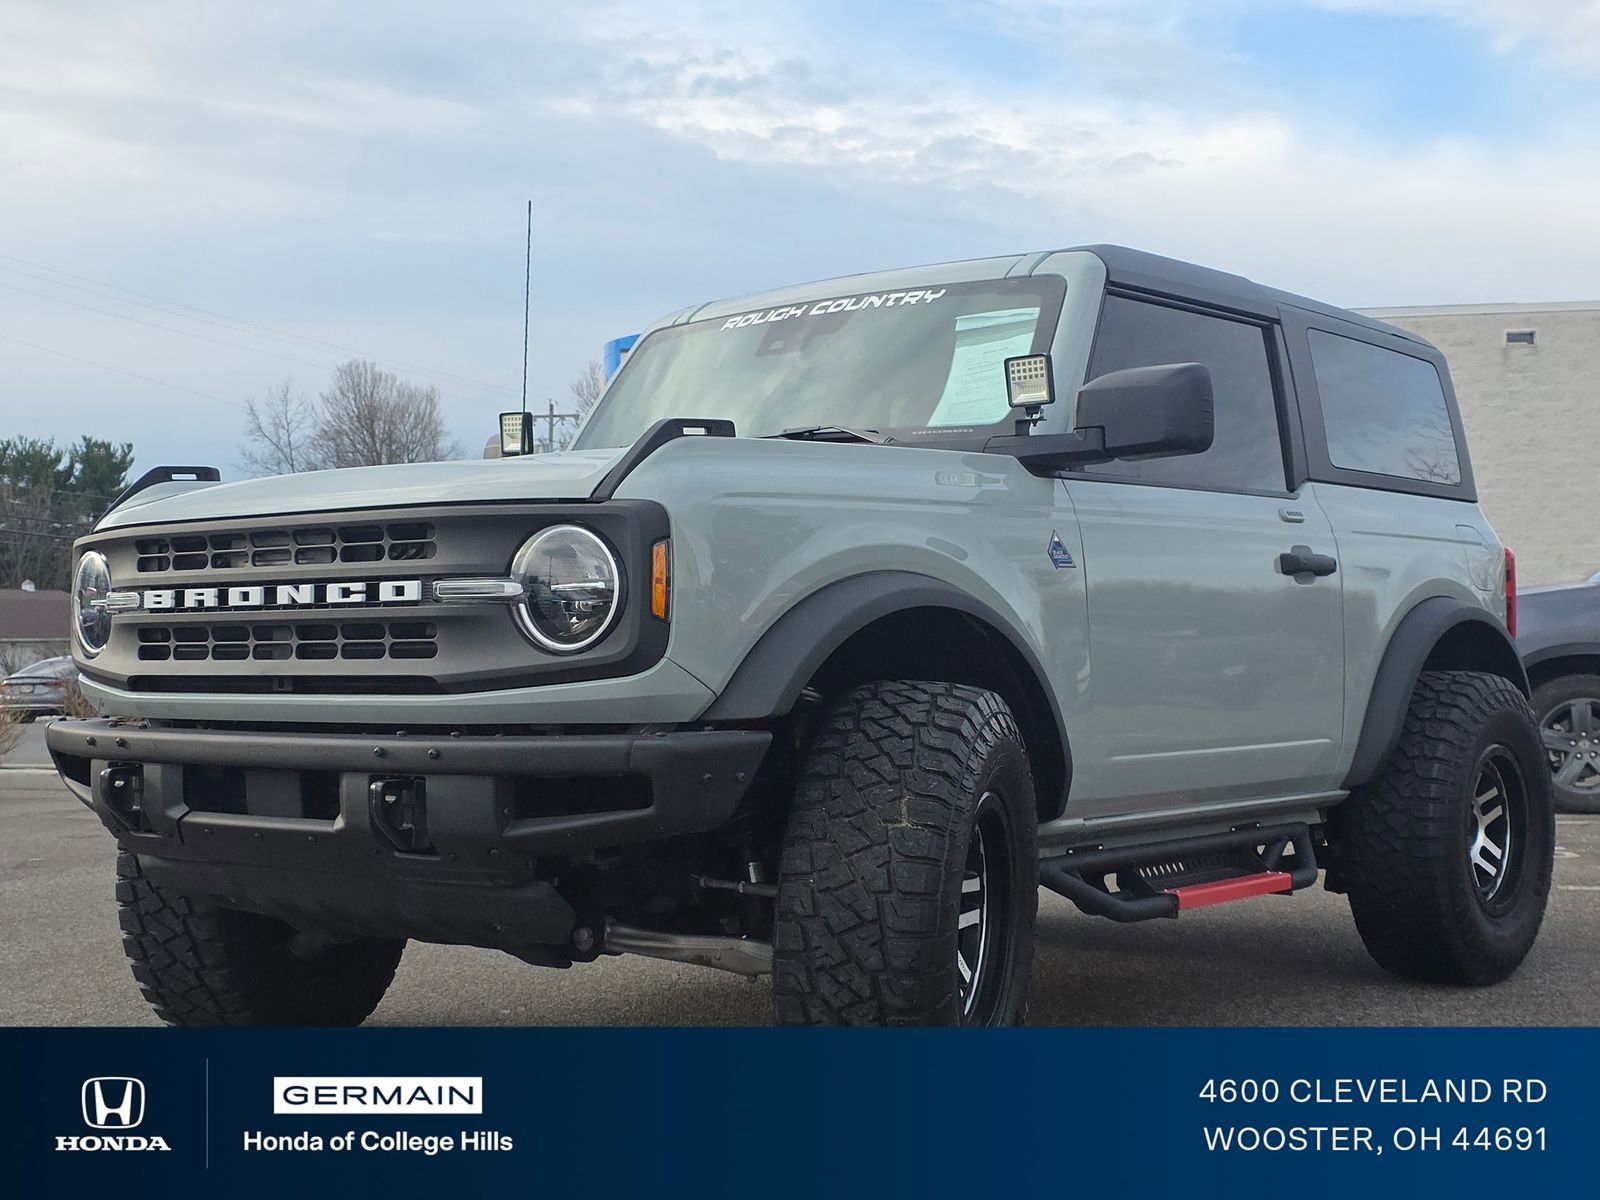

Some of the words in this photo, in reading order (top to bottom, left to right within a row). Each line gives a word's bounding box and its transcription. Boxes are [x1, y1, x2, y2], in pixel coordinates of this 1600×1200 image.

[719, 304, 809, 331] ROUGH
[808, 288, 947, 316] COUNTRY
[143, 579, 422, 609] BRONCO
